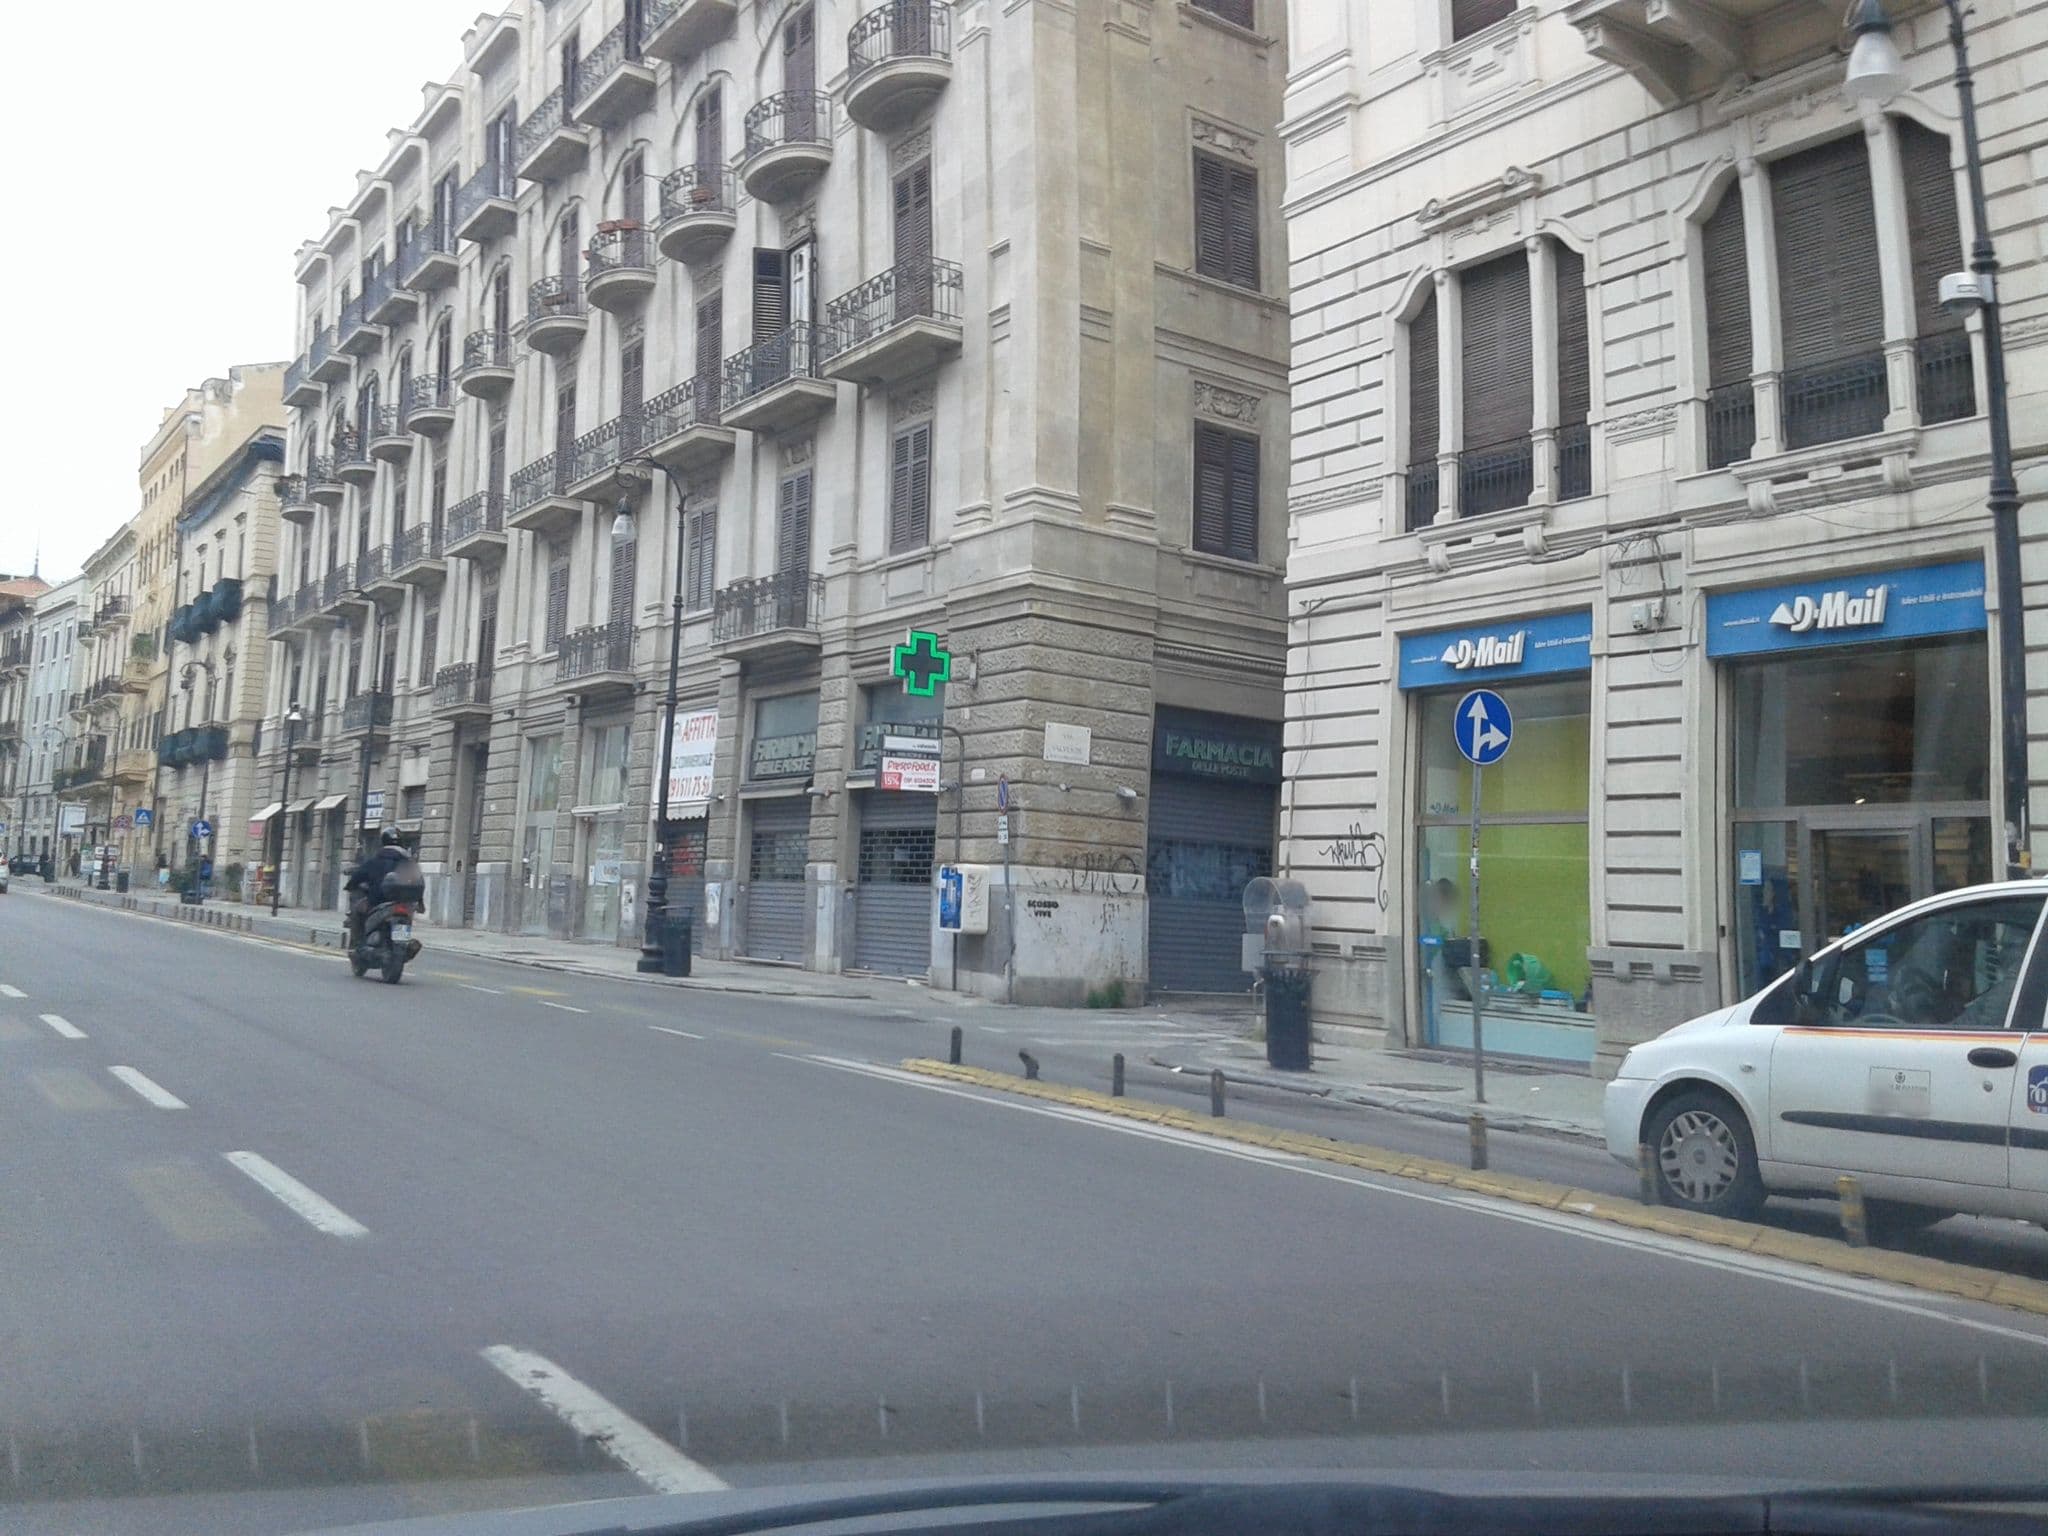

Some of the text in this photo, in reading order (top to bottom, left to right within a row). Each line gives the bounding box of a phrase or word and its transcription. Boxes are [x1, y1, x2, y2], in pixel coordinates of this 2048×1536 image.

[1790, 584, 1888, 632] D-Mail
[1455, 630, 1526, 669] D-Mail
[1166, 733, 1275, 769] FARMACIA
